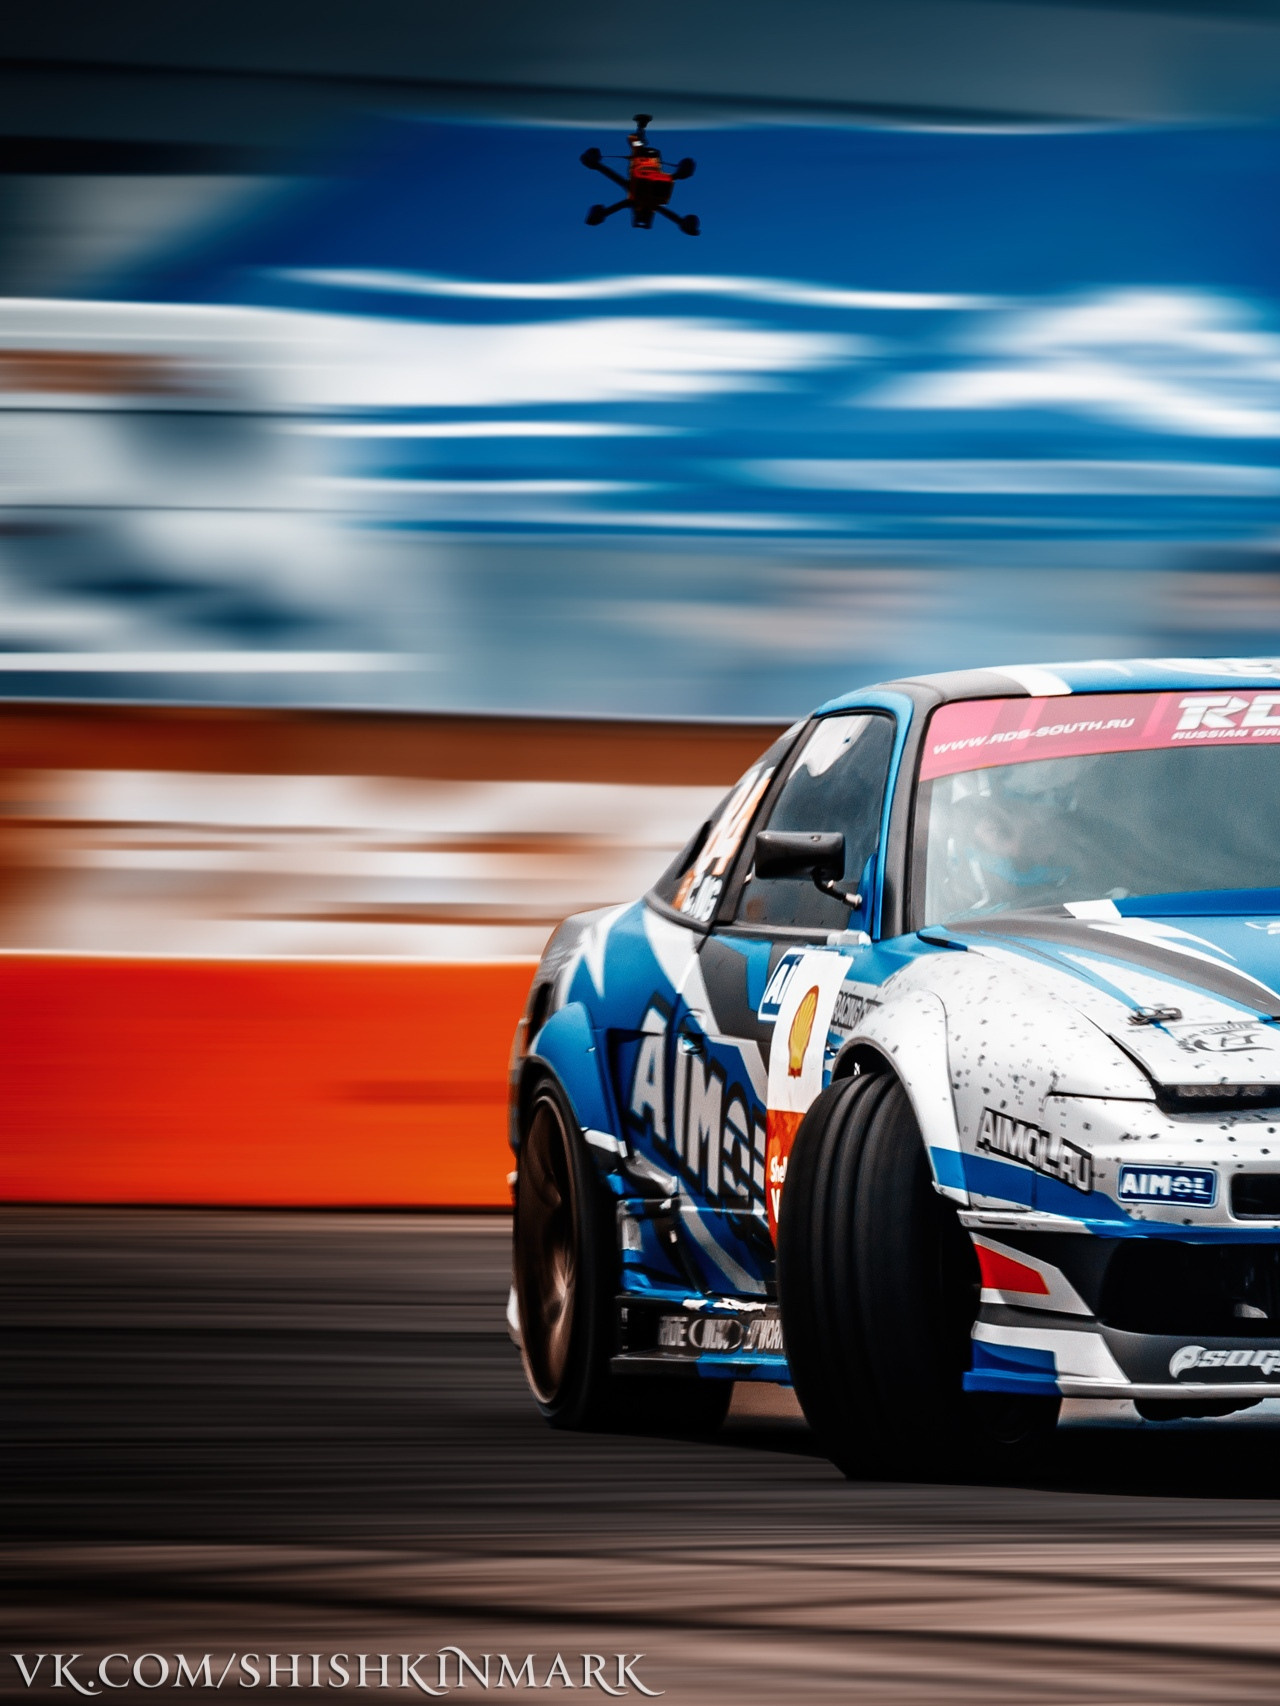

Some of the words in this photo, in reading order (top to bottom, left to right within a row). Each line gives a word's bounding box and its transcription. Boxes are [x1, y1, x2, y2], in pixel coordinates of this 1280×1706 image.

[932, 717, 1135, 755] WWW.RDS-SOUTH.RU
[1171, 727, 1250, 740] RUSSIAN
[1122, 1172, 1212, 1200] AIMOL
